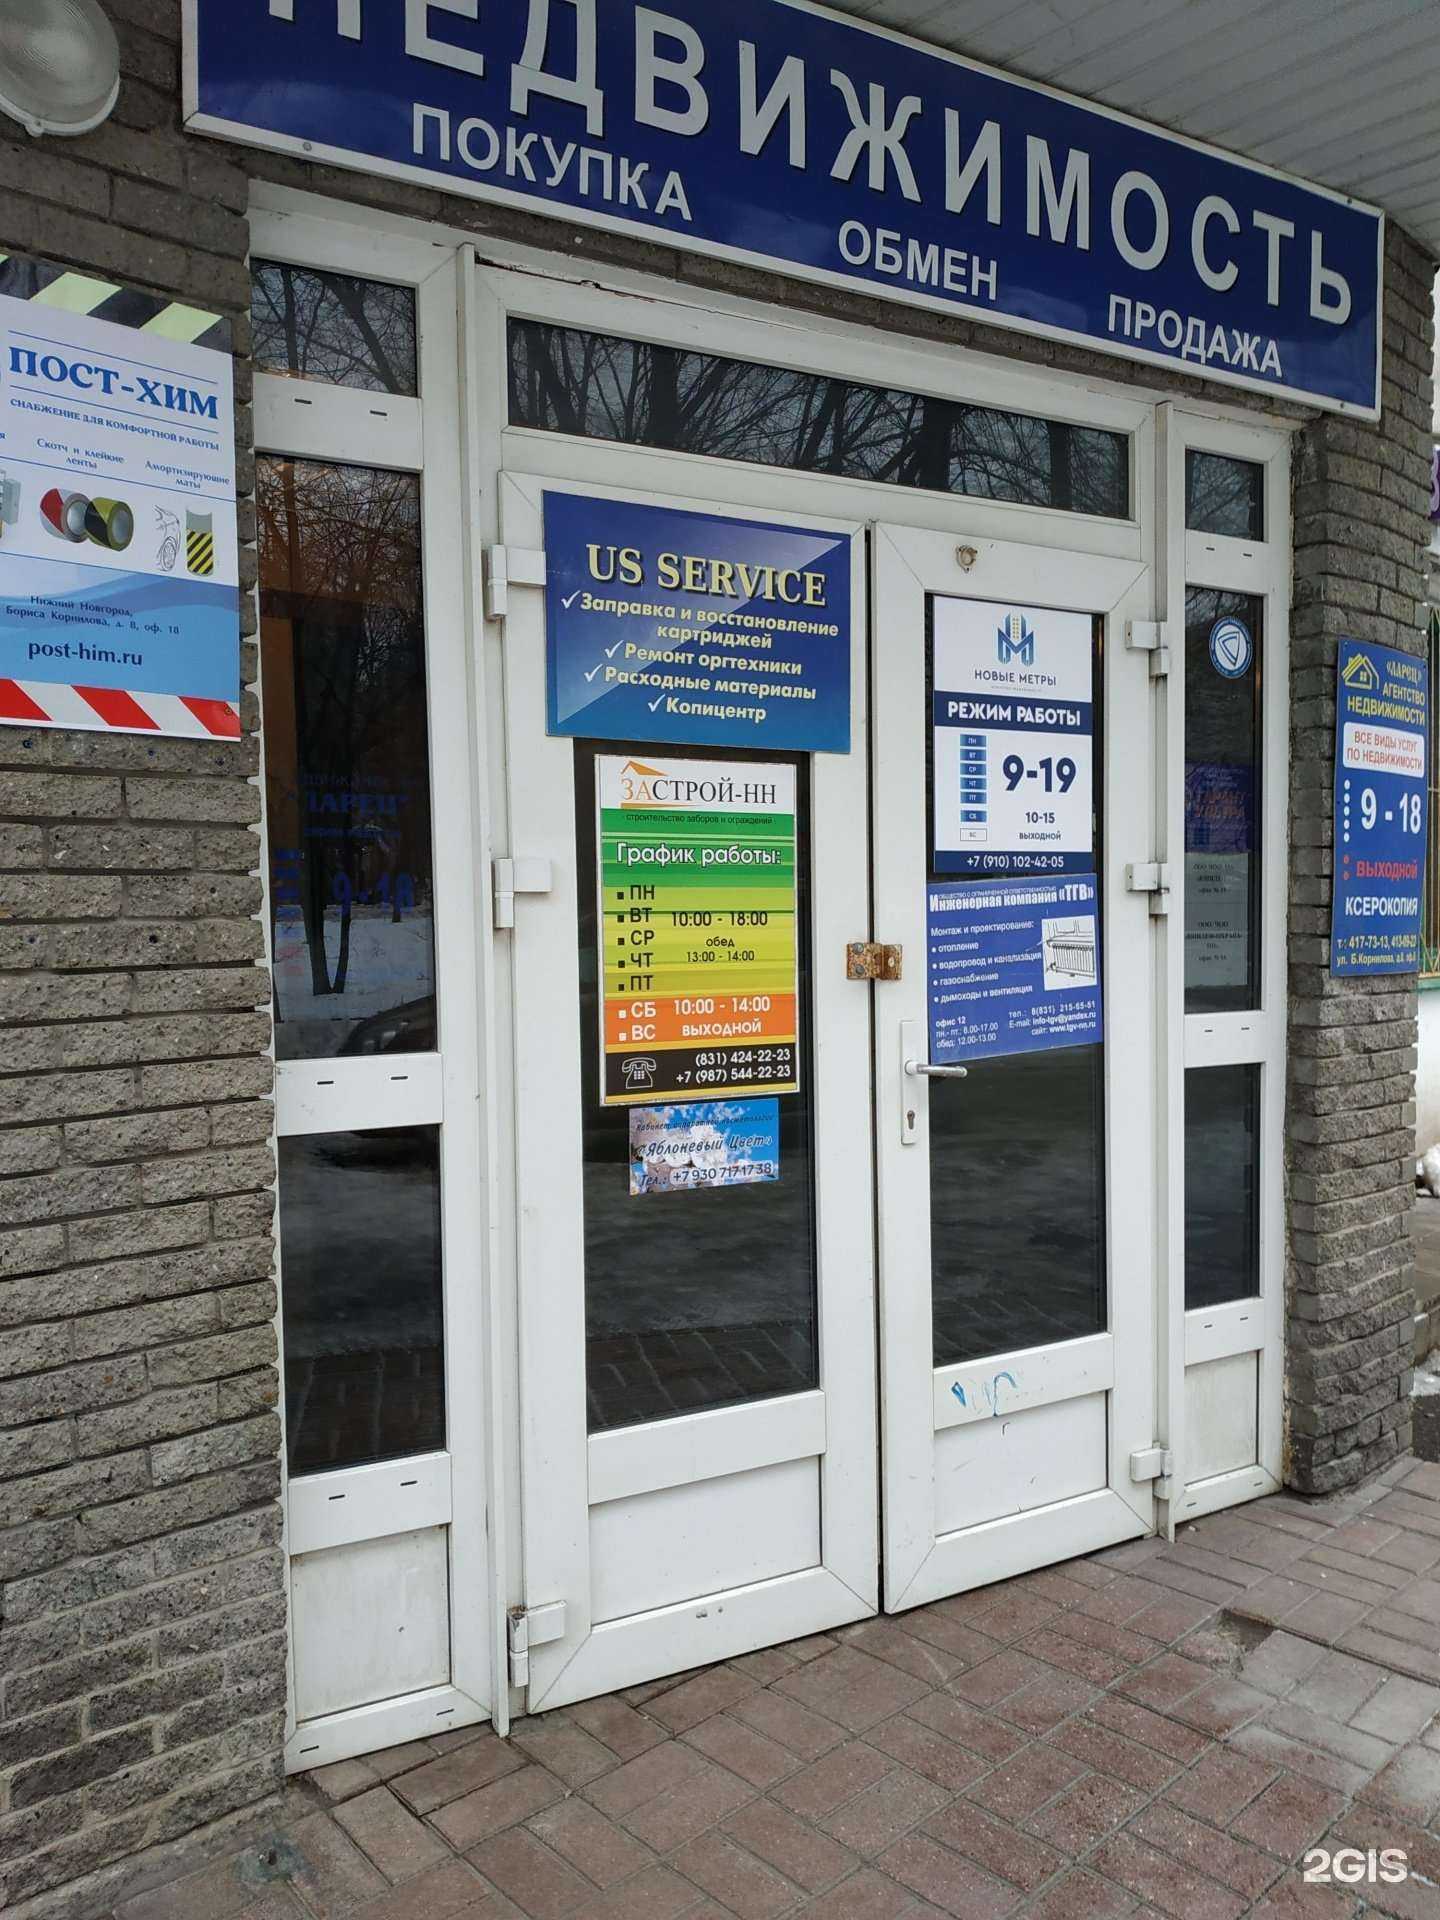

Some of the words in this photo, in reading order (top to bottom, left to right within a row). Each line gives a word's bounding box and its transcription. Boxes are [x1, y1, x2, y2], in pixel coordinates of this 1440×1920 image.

[413, 102, 692, 221] ПОКУПКА
[838, 219, 998, 300] ОБМЕН
[1107, 293, 1283, 379] ПРОДАЖА
[8, 346, 219, 420] ПОСТ-ХИМ
[10, 398, 81, 421] СНАБЖЕНИЕ
[83, 414, 104, 425] ДЛЯ
[106, 418, 177, 442] КОМФОРТНОЙ
[179, 435, 219, 450] РАБОТЫ
[37, 438, 68, 453] Скотч
[85, 449, 124, 463] клейкие
[66, 457, 97, 468] ленты
[145, 461, 230, 485] Амортизирующие
[176, 479, 201, 489] маты
[586, 543, 644, 584] US
[657, 552, 827, 607] SERVICE
[6, 605, 45, 619] Бориса
[30, 595, 74, 609] Нижний
[80, 601, 133, 617] Новгород,
[580, 592, 676, 619] Заправка
[680, 608, 692, 620] и
[697, 610, 839, 637] восстановление
[657, 625, 772, 649] картриджей
[28, 641, 143, 666] post-him.ru
[624, 642, 694, 666] Ремонт
[698, 652, 802, 675] оргтехники
[605, 666, 711, 691] Расходные
[714, 674, 817, 700] материалы
[974, 669, 1015, 683] НОВЫЕ
[1019, 672, 1057, 686] МЕТРЫ
[1382, 681, 1426, 706] АГЕНТСТВО
[666, 697, 767, 724] Копицентр
[947, 700, 1012, 722] РЕЖИМ
[1016, 707, 1081, 727] РАБОТЫ
[1347, 695, 1426, 727] НЕДВИЖИМОСТИ
[1354, 730, 1372, 746] ВСЕ
[1374, 733, 1397, 749] ВИДЫ
[1346, 747, 1361, 761] ПО
[1362, 749, 1422, 770] НЕДВИЖИМОСТИ
[1002, 754, 1077, 794] 9-19
[621, 777, 777, 804] ЗАСТРОЙ-НН
[626, 813, 685, 823] строительство
[687, 814, 719, 824] заборов
[727, 815, 773, 825] ограждений
[1024, 811, 1056, 824] 10-15
[1360, 787, 1377, 831] 9
[1399, 792, 1422, 835] 18
[616, 841, 697, 867] График
[700, 843, 782, 867] работы:
[966, 856, 980, 868] +7
[983, 855, 1010, 869] (910)
[1012, 855, 1065, 868] 102-42-05
[630, 885, 655, 900] ПН
[929, 893, 1002, 912] Инженерная
[1003, 891, 1058, 906] компания
[1058, 883, 1094, 901] «ТГВ»
[630, 907, 653, 923] ВТ
[1345, 896, 1418, 917] КСЕРОКОПИЯ
[671, 912, 712, 927] 10:00
[730, 911, 768, 926] 18:00
[930, 926, 962, 937] Монтаж
[963, 926, 969, 934] и
[970, 920, 1035, 934] проектирование:
[630, 930, 655, 946] СР
[705, 936, 735, 948] обед
[938, 942, 979, 953] отопление
[630, 953, 653, 968] ЧТ
[686, 951, 715, 963] 13:00
[727, 950, 755, 962] 14:00
[939, 958, 986, 970] водопровод
[994, 951, 1041, 964] канализация
[630, 975, 654, 991] ПТ
[940, 971, 999, 986] газоснабжение
[940, 991, 982, 1003] дымоходы
[989, 985, 1033, 997] вентиляция
[631, 1001, 657, 1018] СБ
[673, 999, 714, 1016] 10:00
[731, 996, 771, 1013] 14:00
[631, 1024, 656, 1041] ВС
[935, 1018, 956, 1028] офис
[957, 1016, 966, 1026] 12
[695, 1052, 727, 1068] (831)
[730, 1048, 790, 1063] 424-22-23
[676, 1071, 691, 1084] +7
[695, 1068, 727, 1084] (987)
[731, 1065, 790, 1080] 544-22-23
[638, 1136, 724, 1157] «Яблоневый
[729, 1135, 773, 1150] Цвет»
